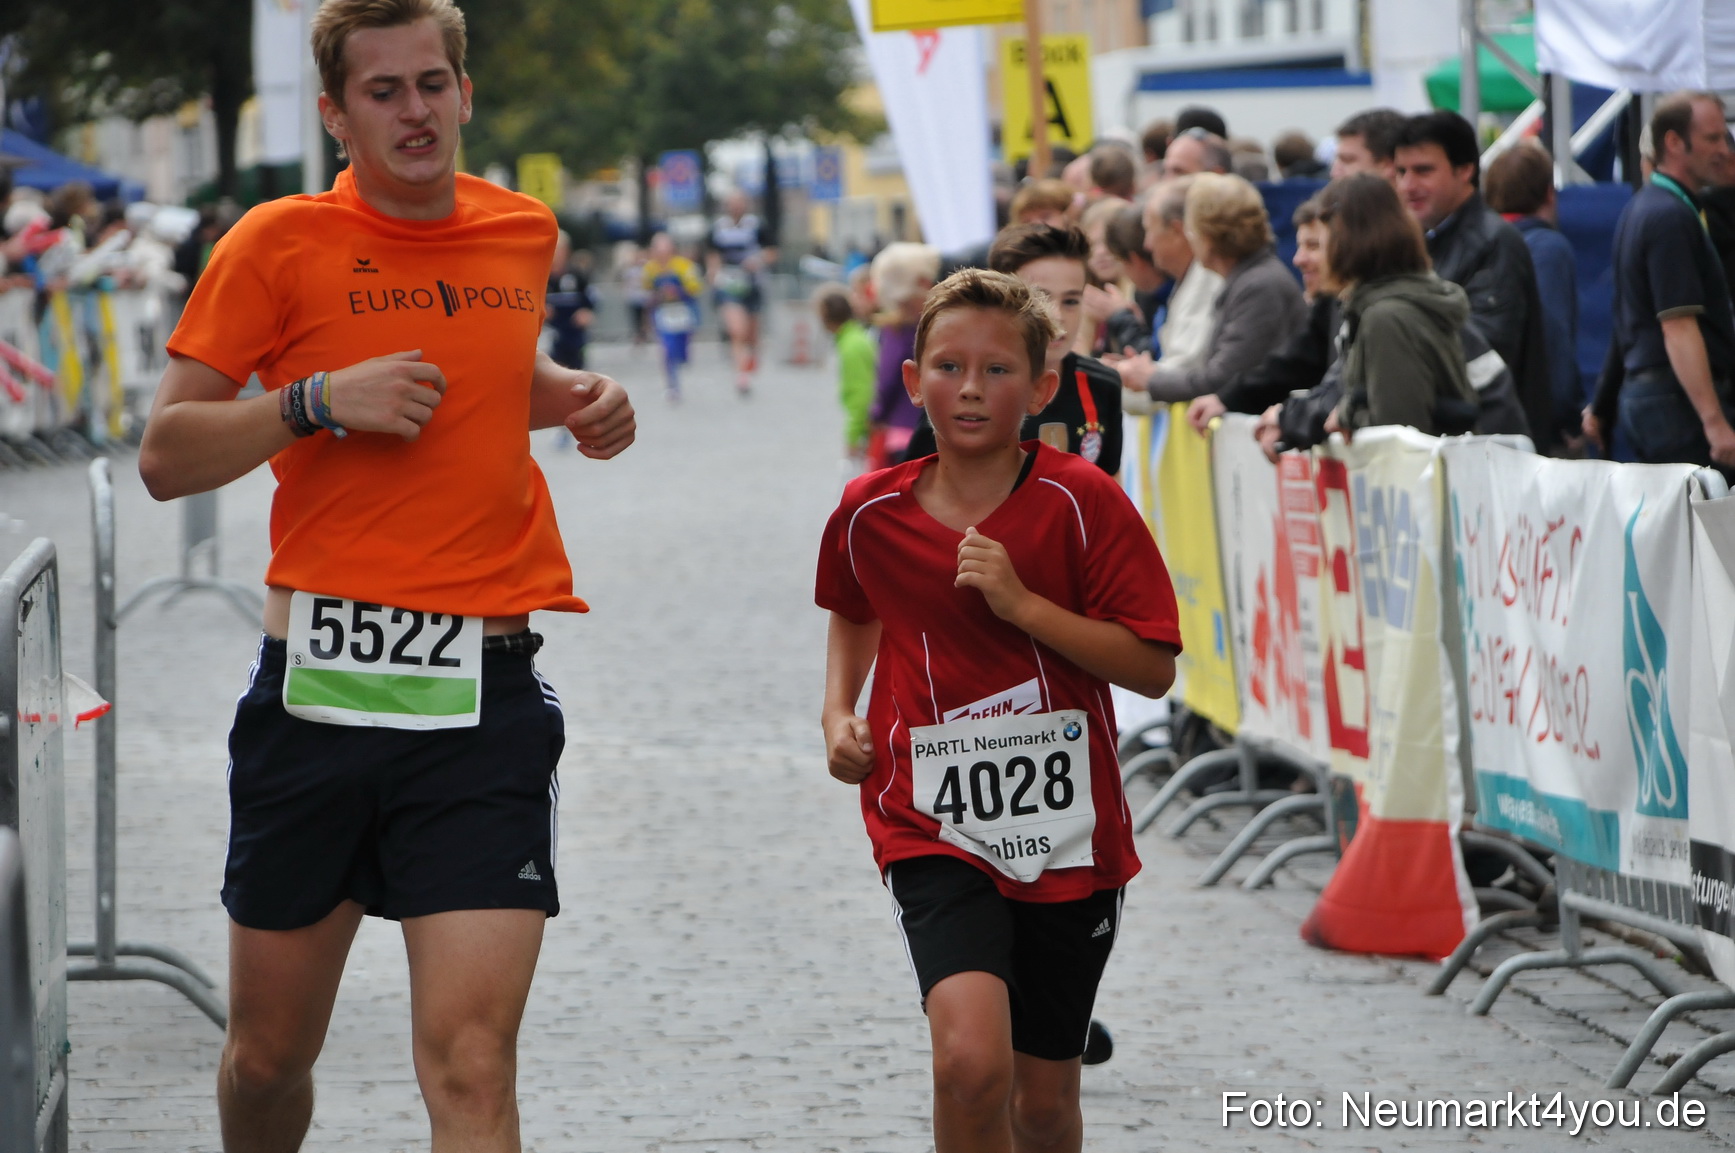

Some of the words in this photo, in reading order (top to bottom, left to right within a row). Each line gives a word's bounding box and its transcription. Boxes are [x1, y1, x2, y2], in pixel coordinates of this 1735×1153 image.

[1026, 78, 1072, 138] A
[349, 288, 434, 314] EURO
[463, 286, 535, 313] POLES
[309, 597, 464, 668] 5522
[295, 655, 302, 665] S
[915, 739, 971, 758] PARTL
[974, 729, 1056, 752] Neumarkt
[933, 750, 1074, 825] 4028
[518, 871, 541, 880] adidas
